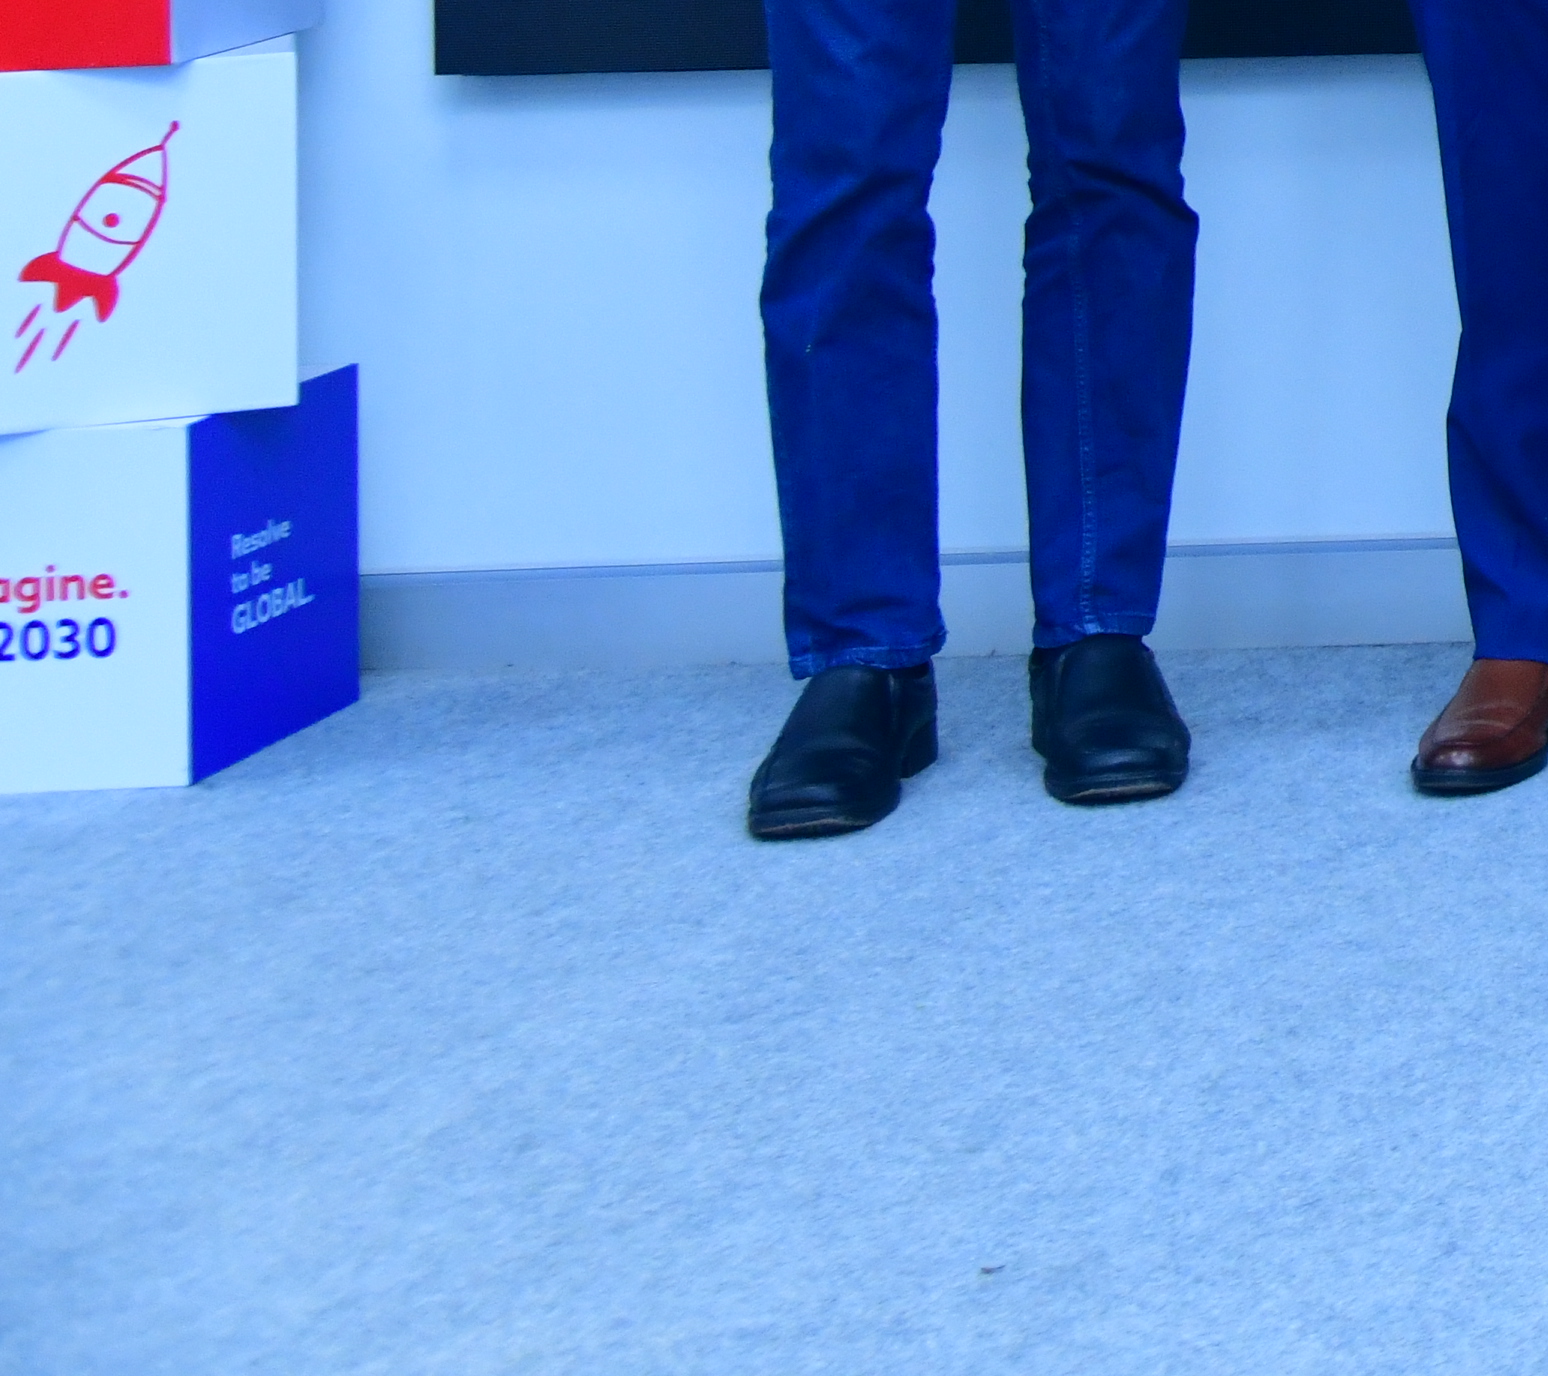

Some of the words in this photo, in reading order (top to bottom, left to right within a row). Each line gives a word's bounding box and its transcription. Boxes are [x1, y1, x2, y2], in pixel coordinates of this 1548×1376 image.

[231, 519, 292, 560] Resolve
[231, 572, 249, 594] to
[251, 560, 272, 586] be
[231, 577, 316, 635] GLOBAL.
[0, 616, 117, 662] 2030
